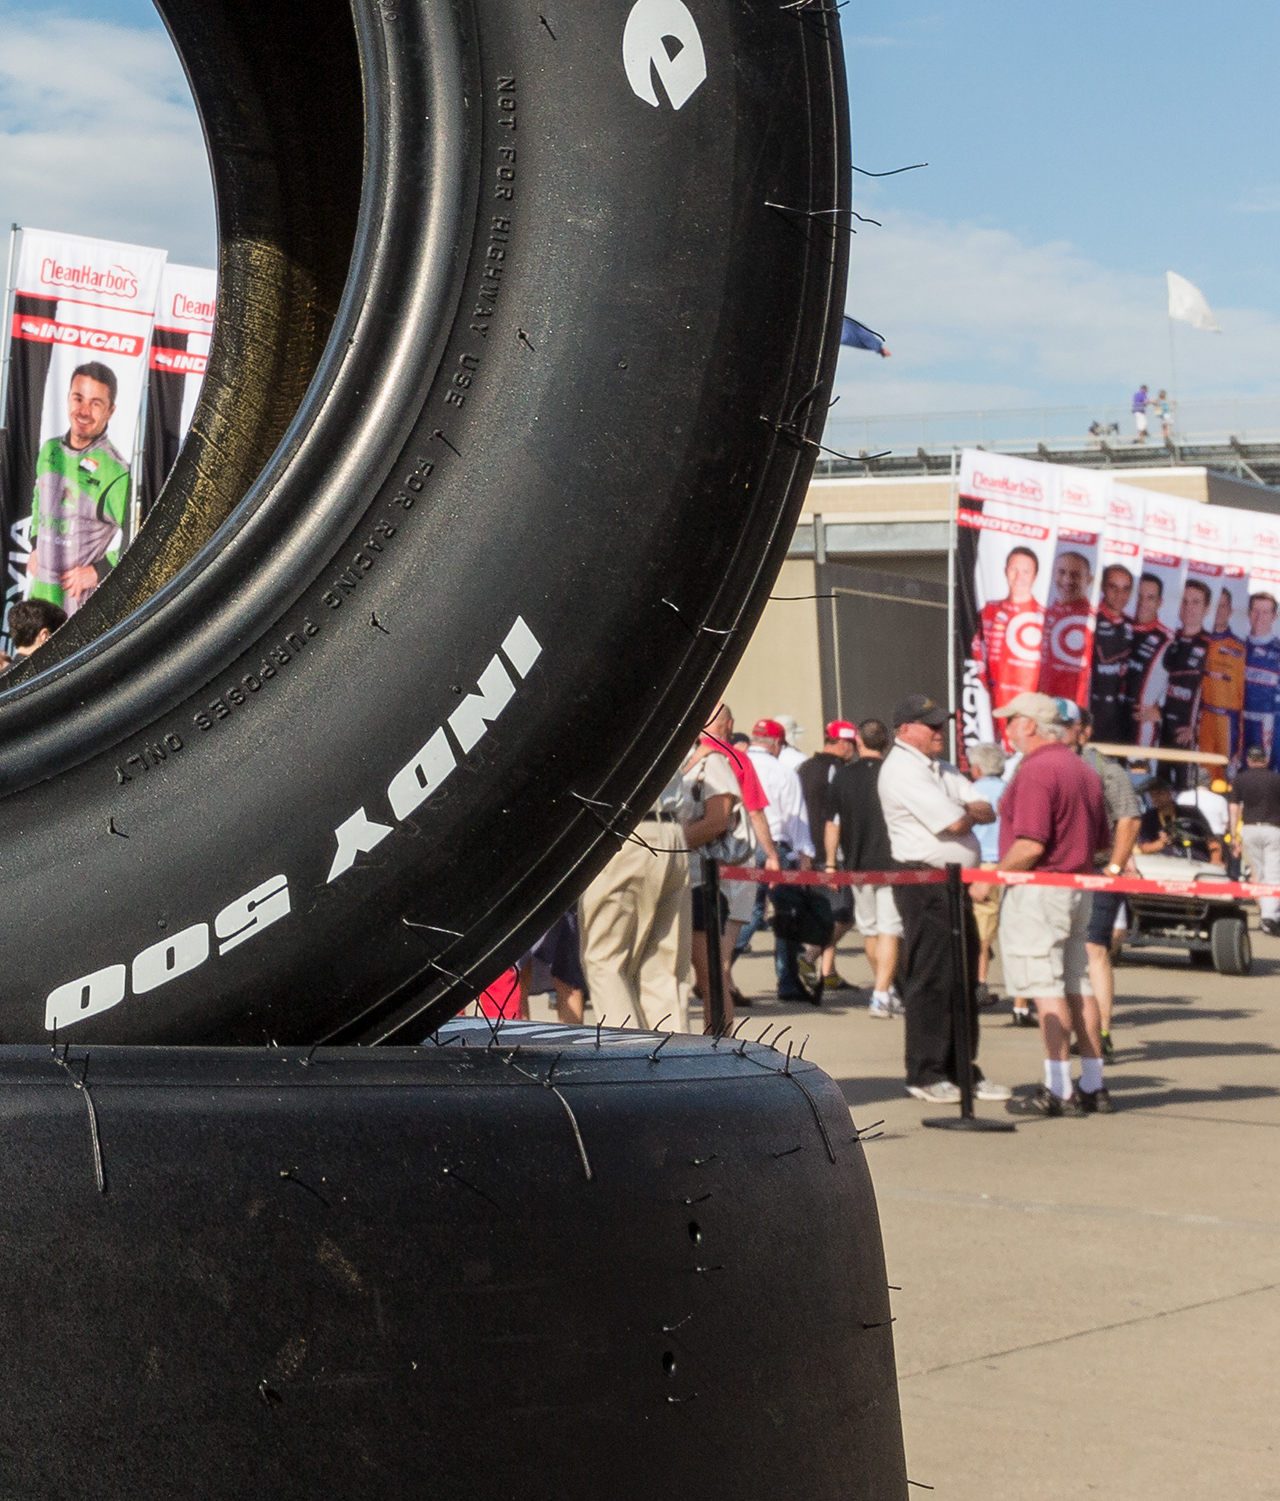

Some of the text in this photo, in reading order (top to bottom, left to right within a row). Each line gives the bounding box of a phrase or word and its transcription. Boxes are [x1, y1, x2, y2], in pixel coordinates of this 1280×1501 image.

[39, 322, 137, 355] INDYCAR
[114, 75, 518, 786] NOT FOR HIGHWAY USE FOR RACING PURPOSES ONLY
[44, 615, 543, 1032] INDY 500
